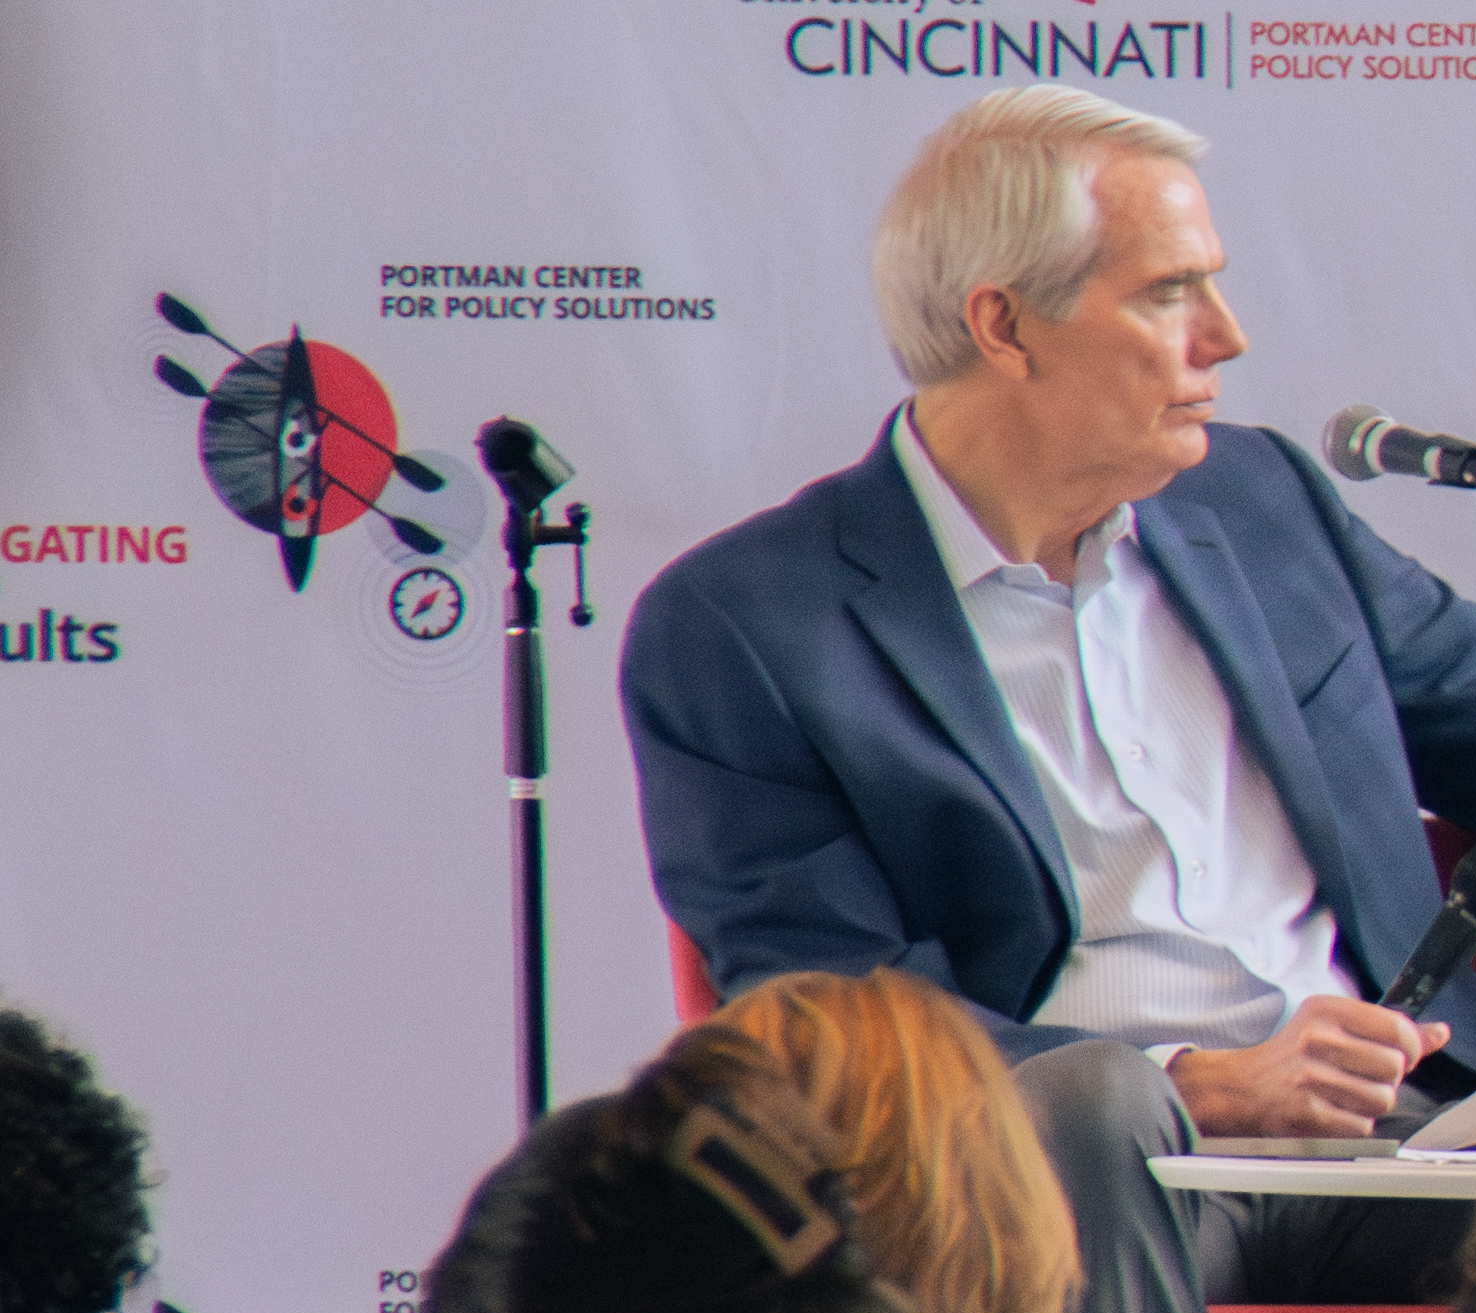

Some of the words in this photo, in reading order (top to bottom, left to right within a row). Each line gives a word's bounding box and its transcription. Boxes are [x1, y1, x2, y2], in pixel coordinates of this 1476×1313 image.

[1250, 21, 1396, 47] PORTMAN
[784, 17, 1207, 79] CINCINNATI
[1250, 54, 1353, 80] POLICY
[379, 264, 525, 290] PORTMAN
[534, 265, 643, 290] CENTER
[380, 295, 435, 320] FOR
[444, 295, 545, 320] POLICY
[553, 296, 716, 321] SOLUTIONS
[0, 524, 187, 564] GATING
[0, 607, 122, 663] ults
